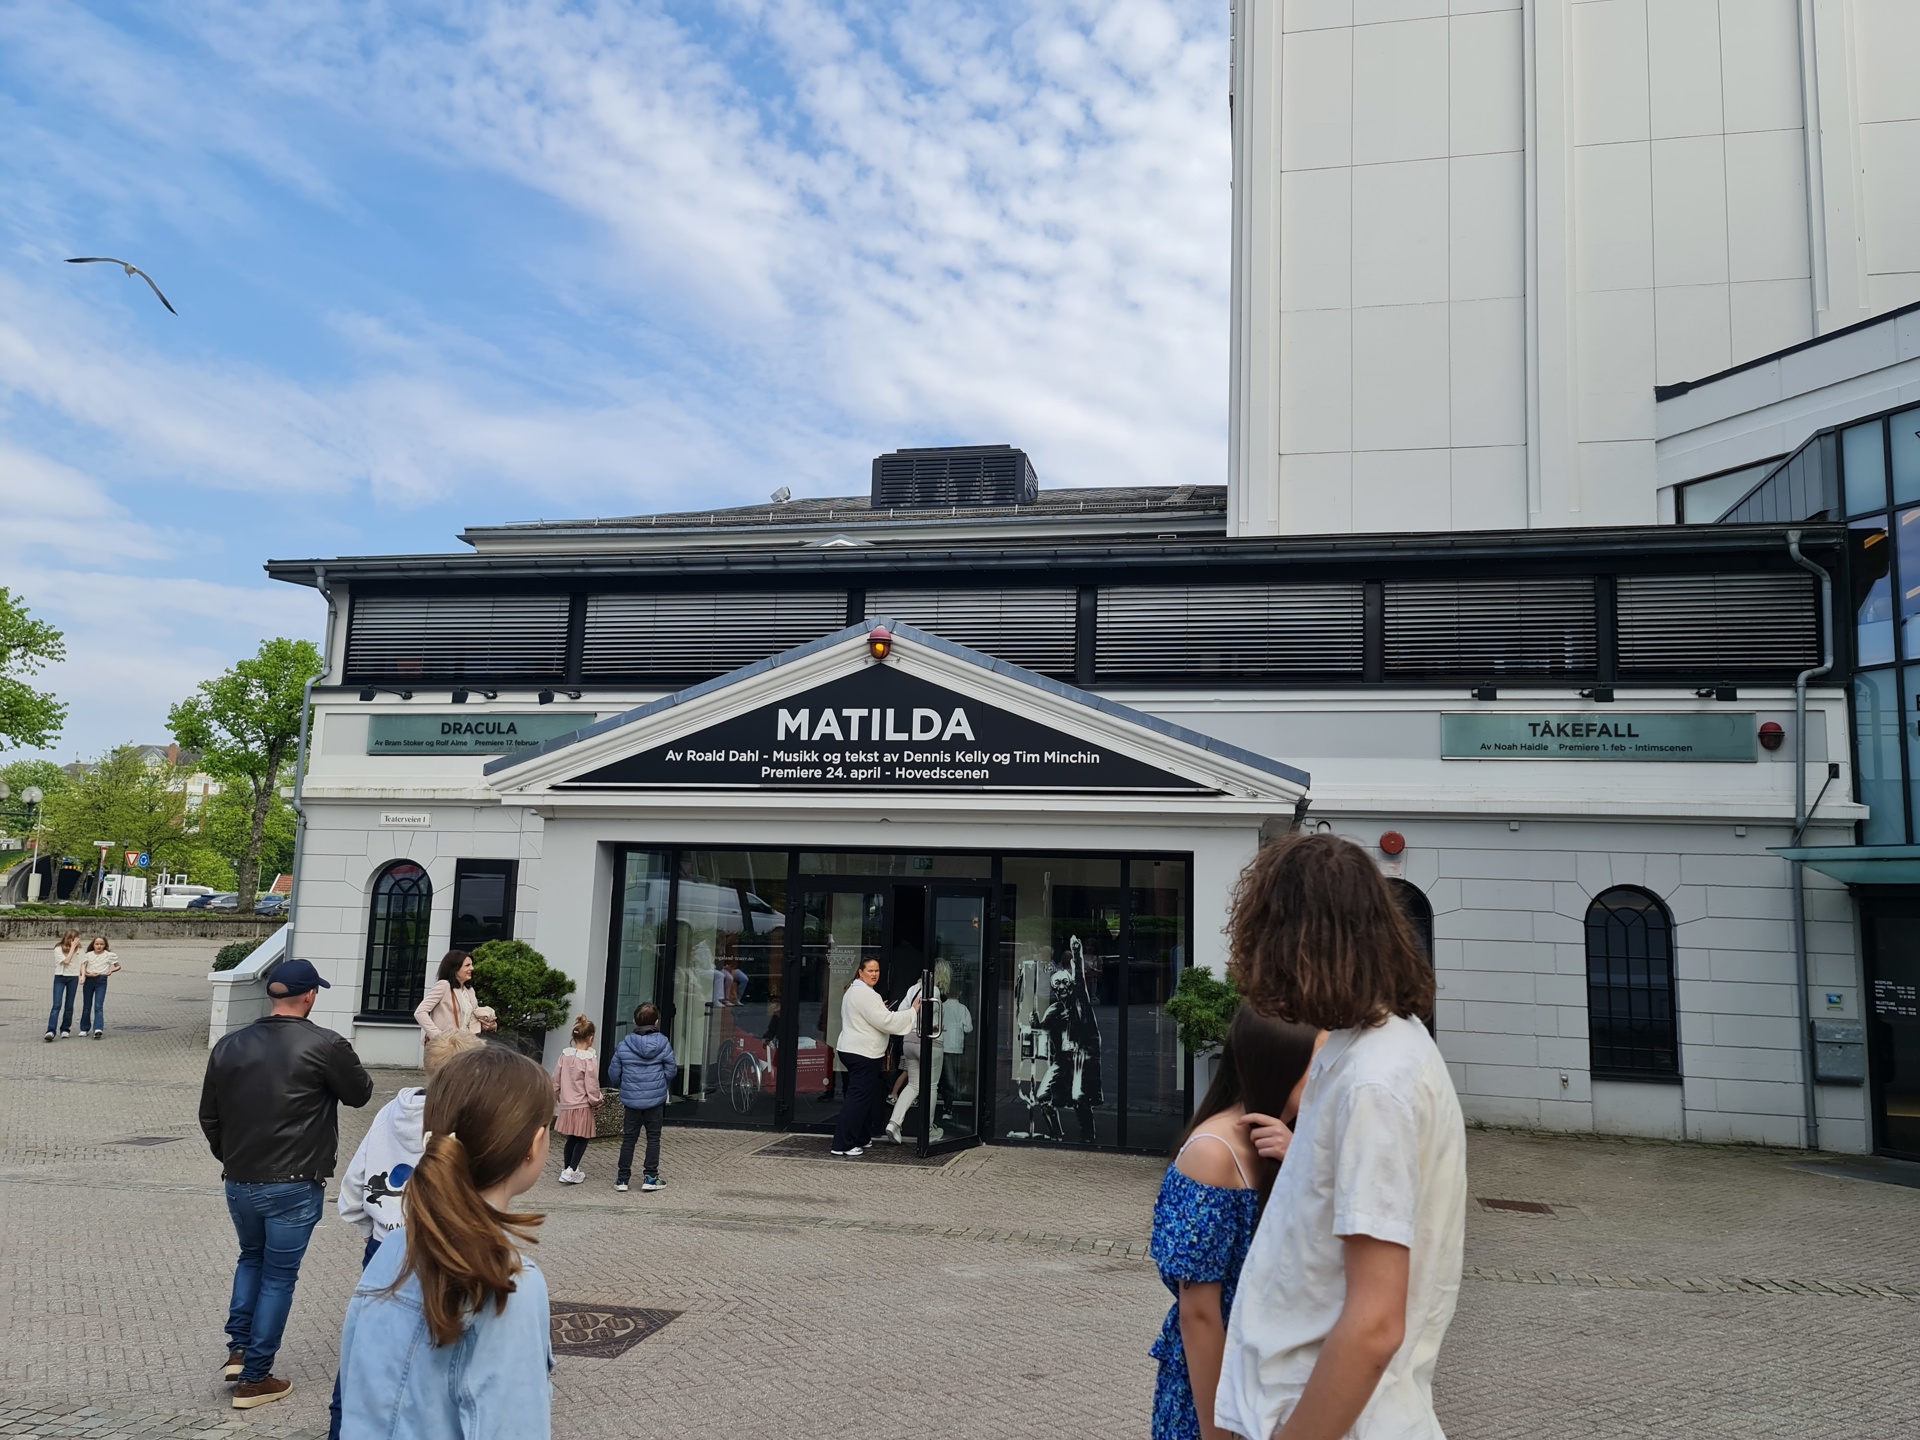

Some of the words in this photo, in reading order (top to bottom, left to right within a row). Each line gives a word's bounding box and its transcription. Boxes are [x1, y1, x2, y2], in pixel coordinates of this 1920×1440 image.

[440, 722, 518, 735] DRACULA
[776, 707, 975, 741] MATILDA
[1528, 720, 1640, 738] TÅKEFALL
[425, 740, 435, 748] og
[1480, 743, 1492, 751] Av
[1494, 743, 1518, 751] Noah
[1520, 743, 1549, 751] Haidle
[1558, 743, 1600, 752] Premiere
[1601, 743, 1609, 752] 1.
[1610, 743, 1627, 752] feb
[1634, 743, 1693, 752] Intimscenen
[665, 750, 684, 762] Av
[686, 749, 725, 762] Roald
[728, 749, 759, 762] Dahl
[772, 750, 820, 763] Musikk
[823, 753, 841, 765] og
[844, 751, 880, 763] tekst
[883, 754, 900, 763] av
[903, 751, 951, 764] Dennis
[955, 751, 991, 766] Kelly
[992, 754, 1011, 765] og
[1014, 751, 1040, 764] Tim
[1044, 751, 1100, 764] Minchin
[761, 766, 823, 779] Premiere
[826, 767, 847, 779] 24.
[850, 767, 881, 781] april
[895, 767, 990, 780] Hovedscenen
[384, 815, 422, 823] Teaterveien
